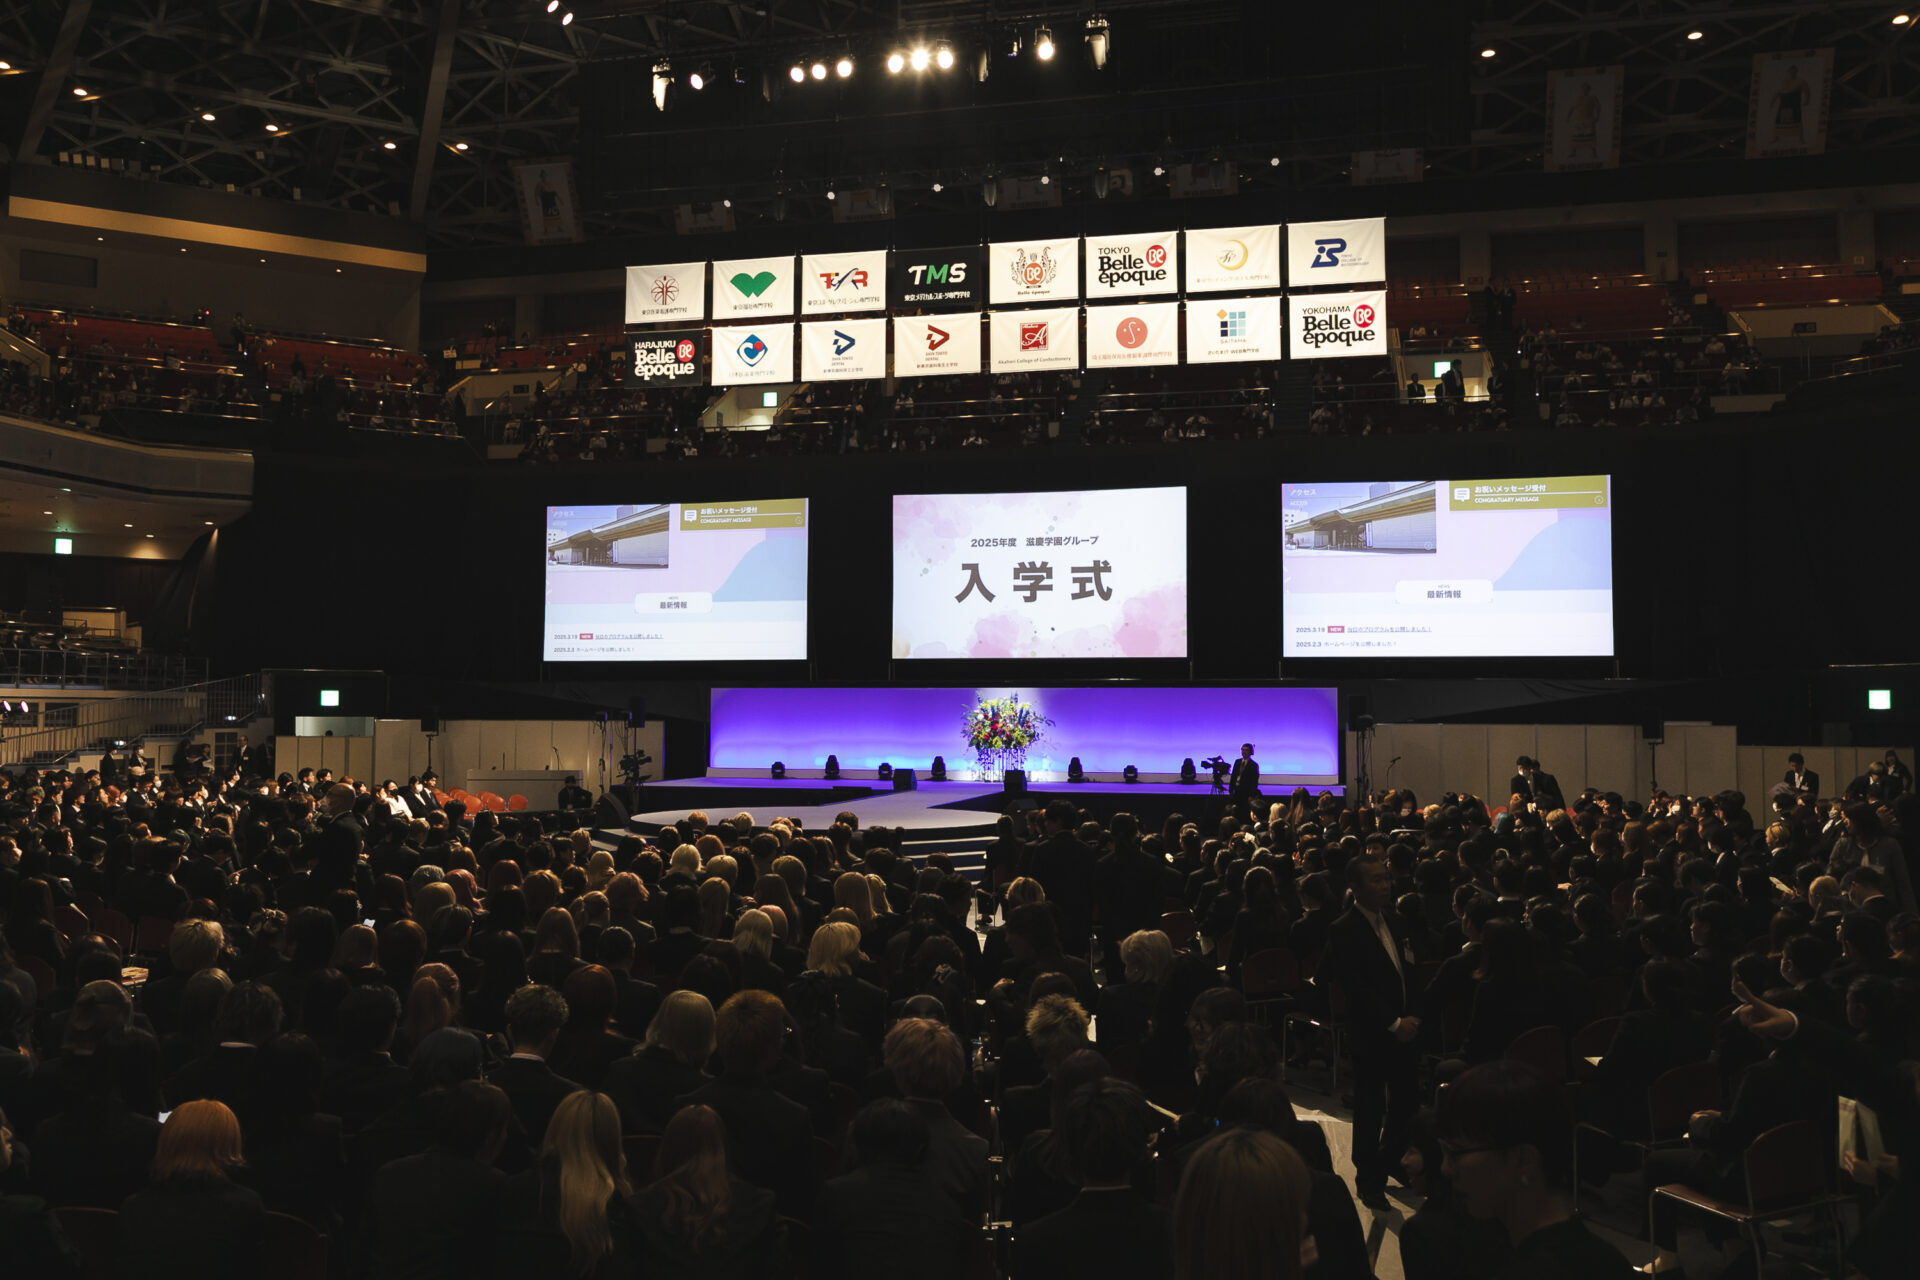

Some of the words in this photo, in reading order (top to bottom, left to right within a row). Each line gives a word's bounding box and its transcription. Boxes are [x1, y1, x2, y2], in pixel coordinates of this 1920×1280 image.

[1098, 246, 1130, 255] TOKYO
[1098, 254, 1144, 271] Belle
[907, 262, 968, 285] TMS
[1098, 268, 1167, 288] époque
[1302, 305, 1351, 315] YOKOHAMA
[1302, 314, 1351, 332] Belle
[635, 340, 677, 350] HARAJUKU
[1302, 329, 1376, 348] époque
[635, 348, 676, 366] Belle
[634, 363, 695, 381] époque
[1474, 483, 1546, 494] お祝いメッセージ受付
[971, 537, 1017, 547] 2025年度
[1026, 535, 1099, 547] 滋慶学園グループ
[1427, 589, 1462, 599] 最新情報
[659, 601, 688, 609] 最新情報
